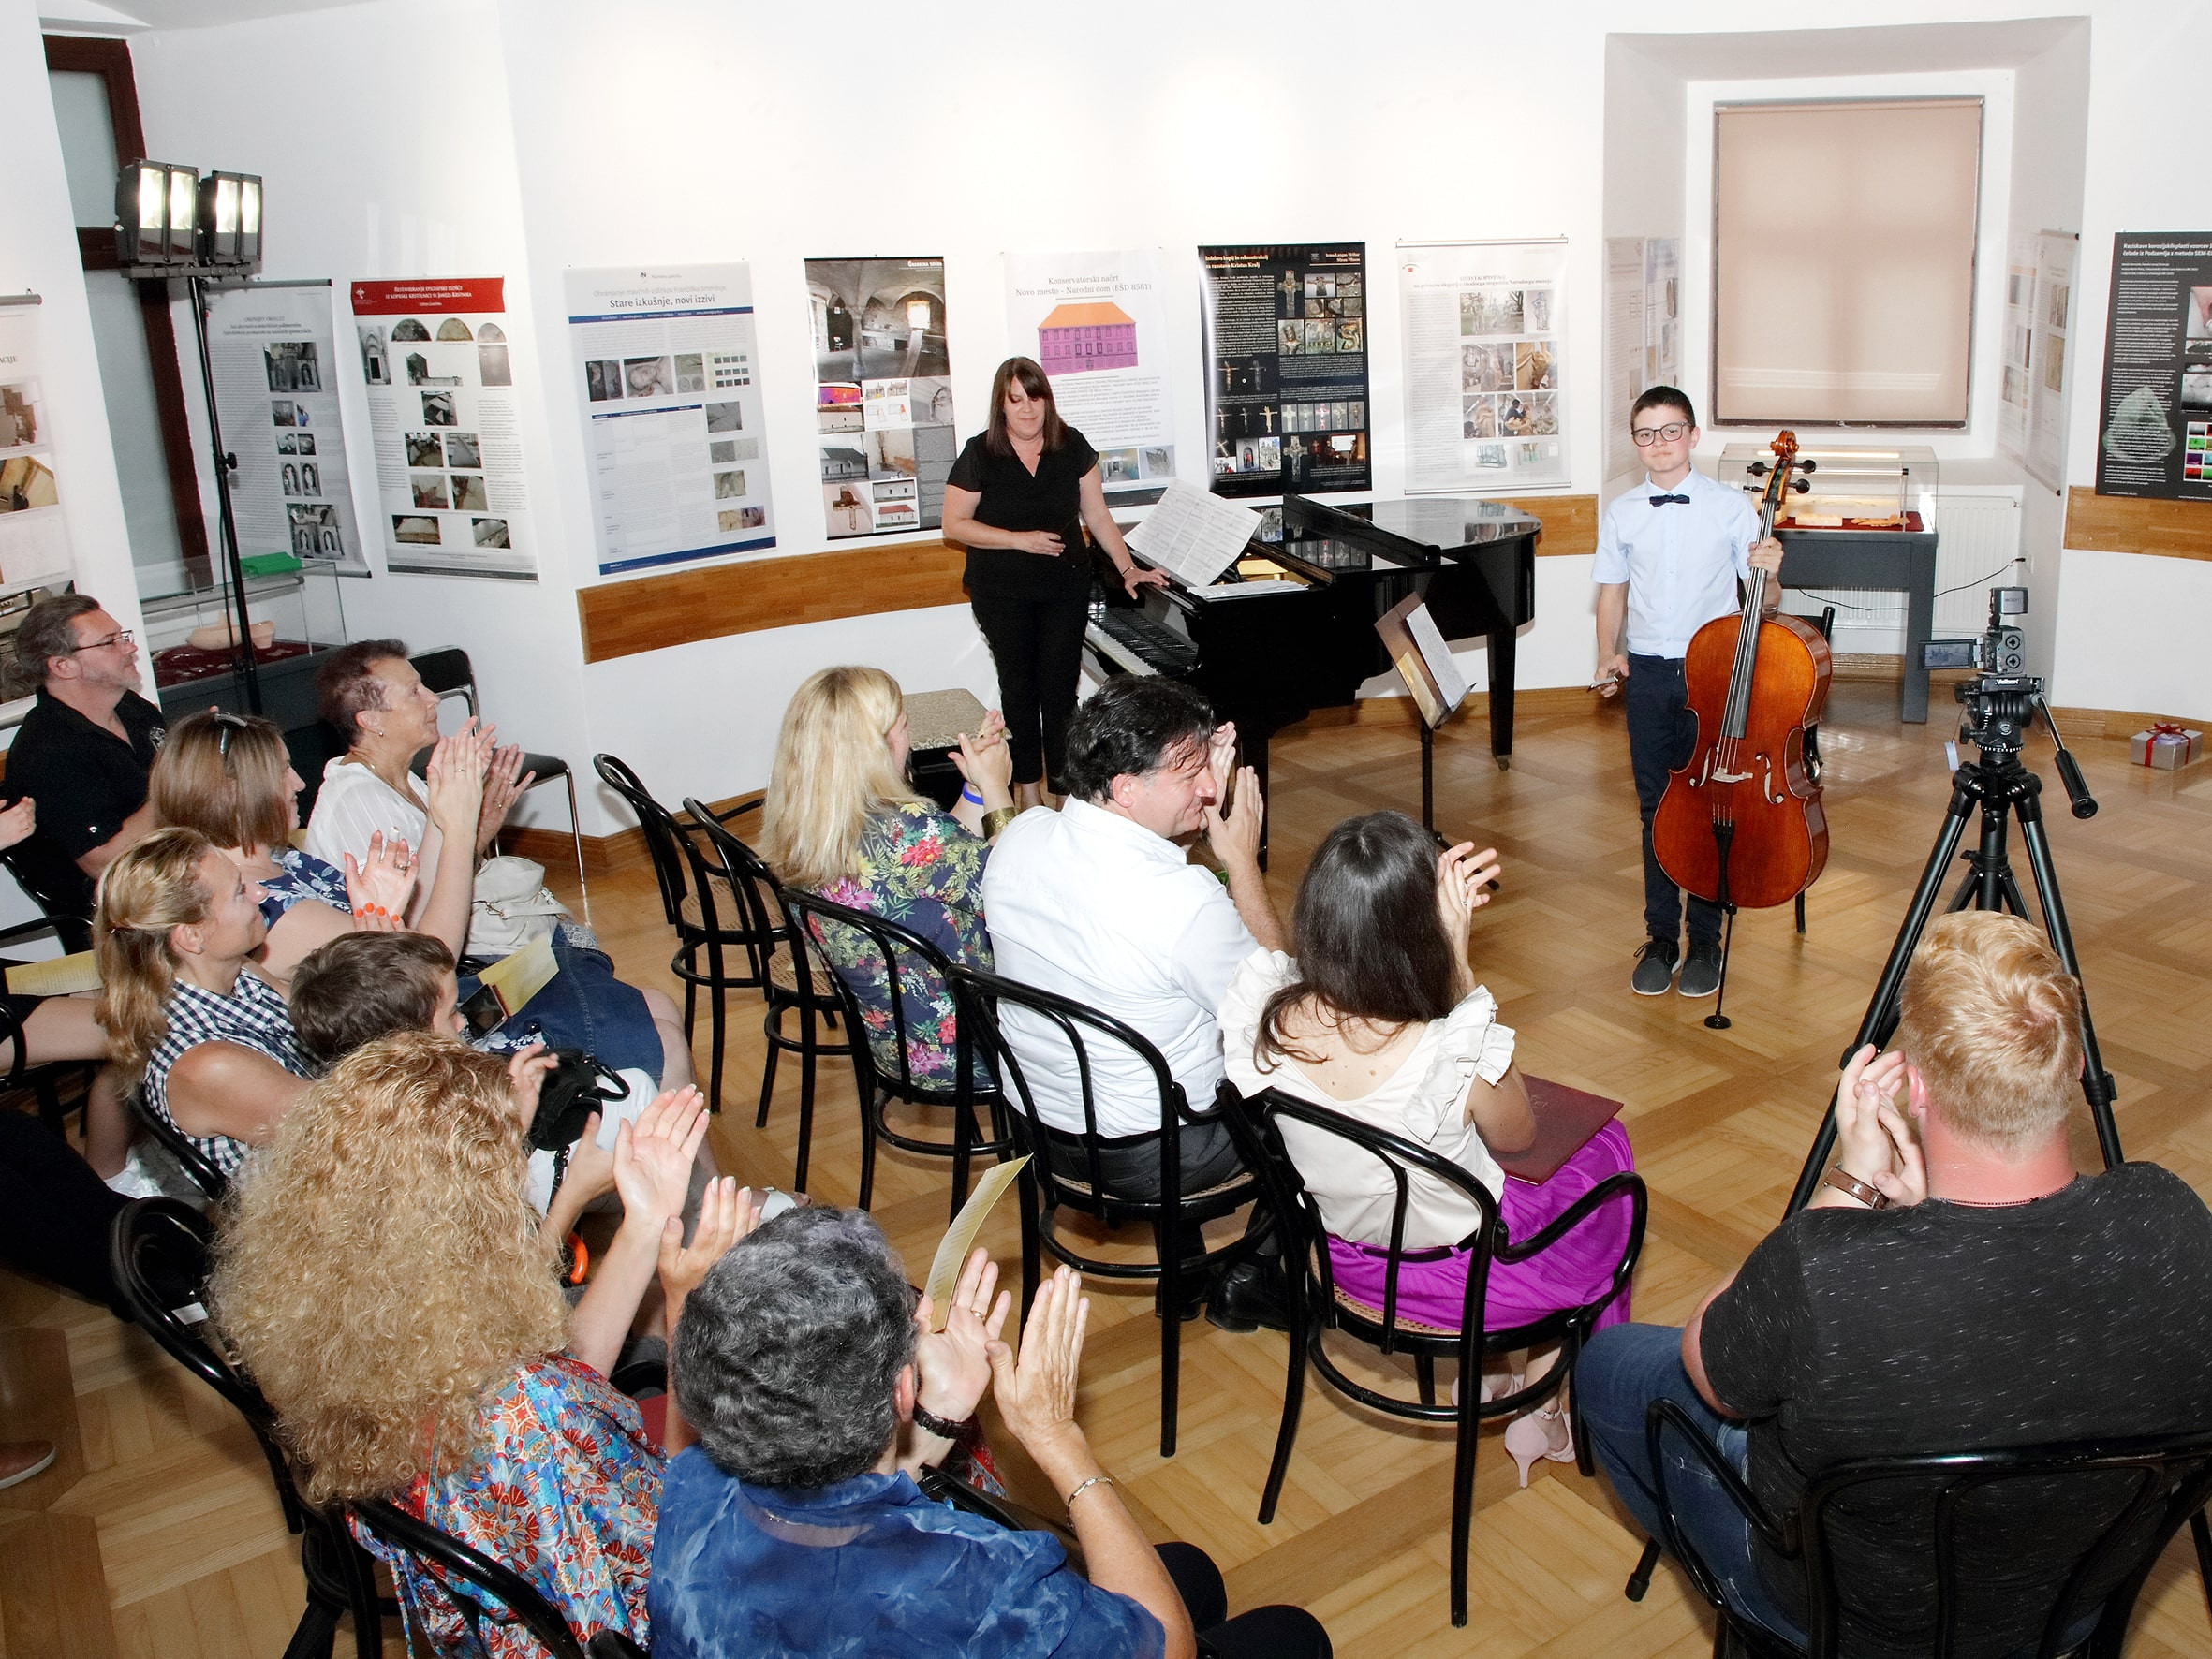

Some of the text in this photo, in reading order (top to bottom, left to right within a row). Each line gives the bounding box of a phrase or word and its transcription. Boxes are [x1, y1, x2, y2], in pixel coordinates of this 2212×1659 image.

[1048, 274, 1119, 285] Konservatorski načrt
[1016, 288, 1035, 297] Novo
[1037, 287, 1059, 296] mesto
[1066, 286, 1094, 295] Narodni
[1096, 285, 1111, 293] dom
[609, 294, 715, 308] Stare izkušnje, novi izzivi
